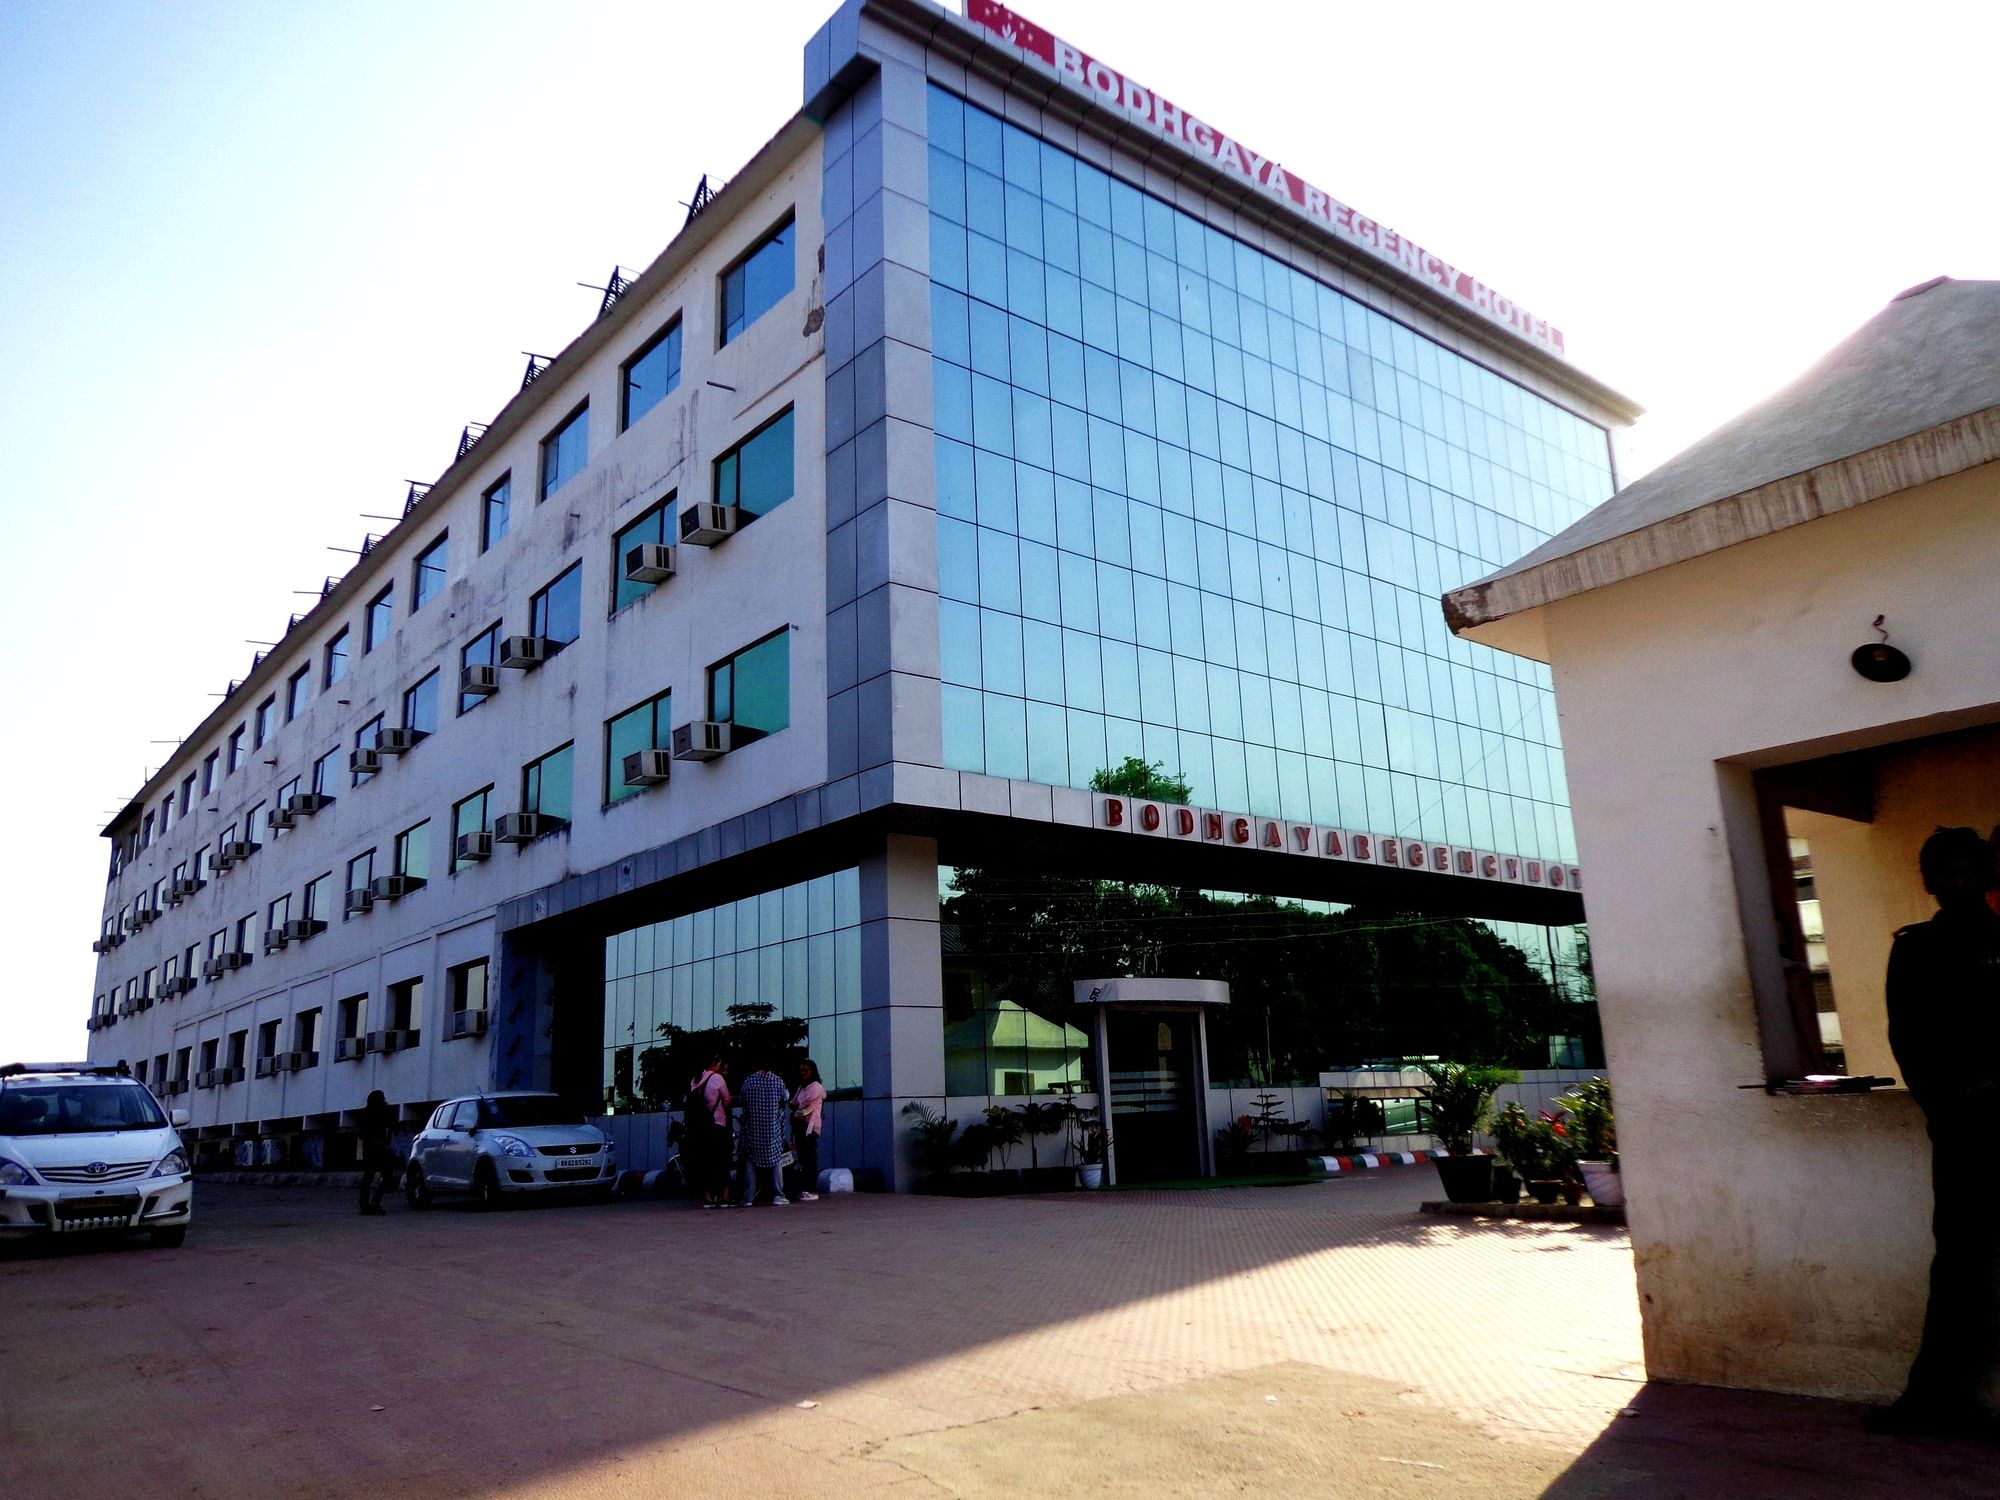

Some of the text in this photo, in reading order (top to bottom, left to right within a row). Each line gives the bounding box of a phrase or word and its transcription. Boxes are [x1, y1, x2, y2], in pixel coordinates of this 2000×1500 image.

[1054, 37, 1562, 347] BODHGAYA REGENCY HOTEL
[1105, 799, 1343, 856] BODHGAYA
[1354, 835, 1518, 879] REGENCY
